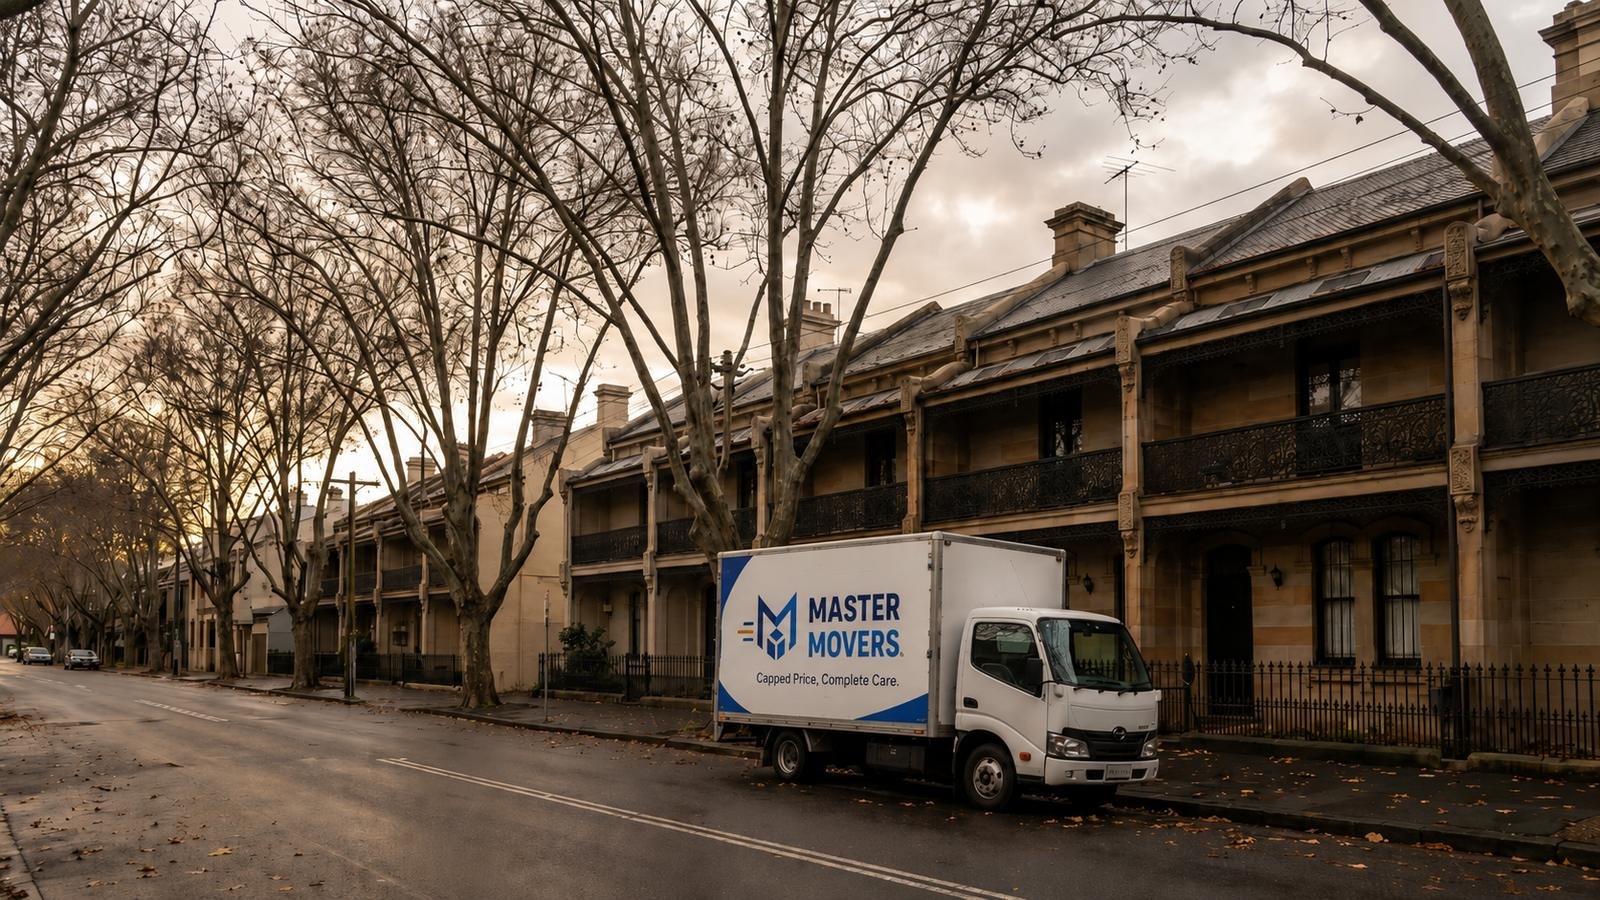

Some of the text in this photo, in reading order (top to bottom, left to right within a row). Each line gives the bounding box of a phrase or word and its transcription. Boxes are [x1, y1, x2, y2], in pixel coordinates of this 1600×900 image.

[808, 593, 901, 623] MASTER
[756, 672, 900, 688] Capped Price, Complete Care.
